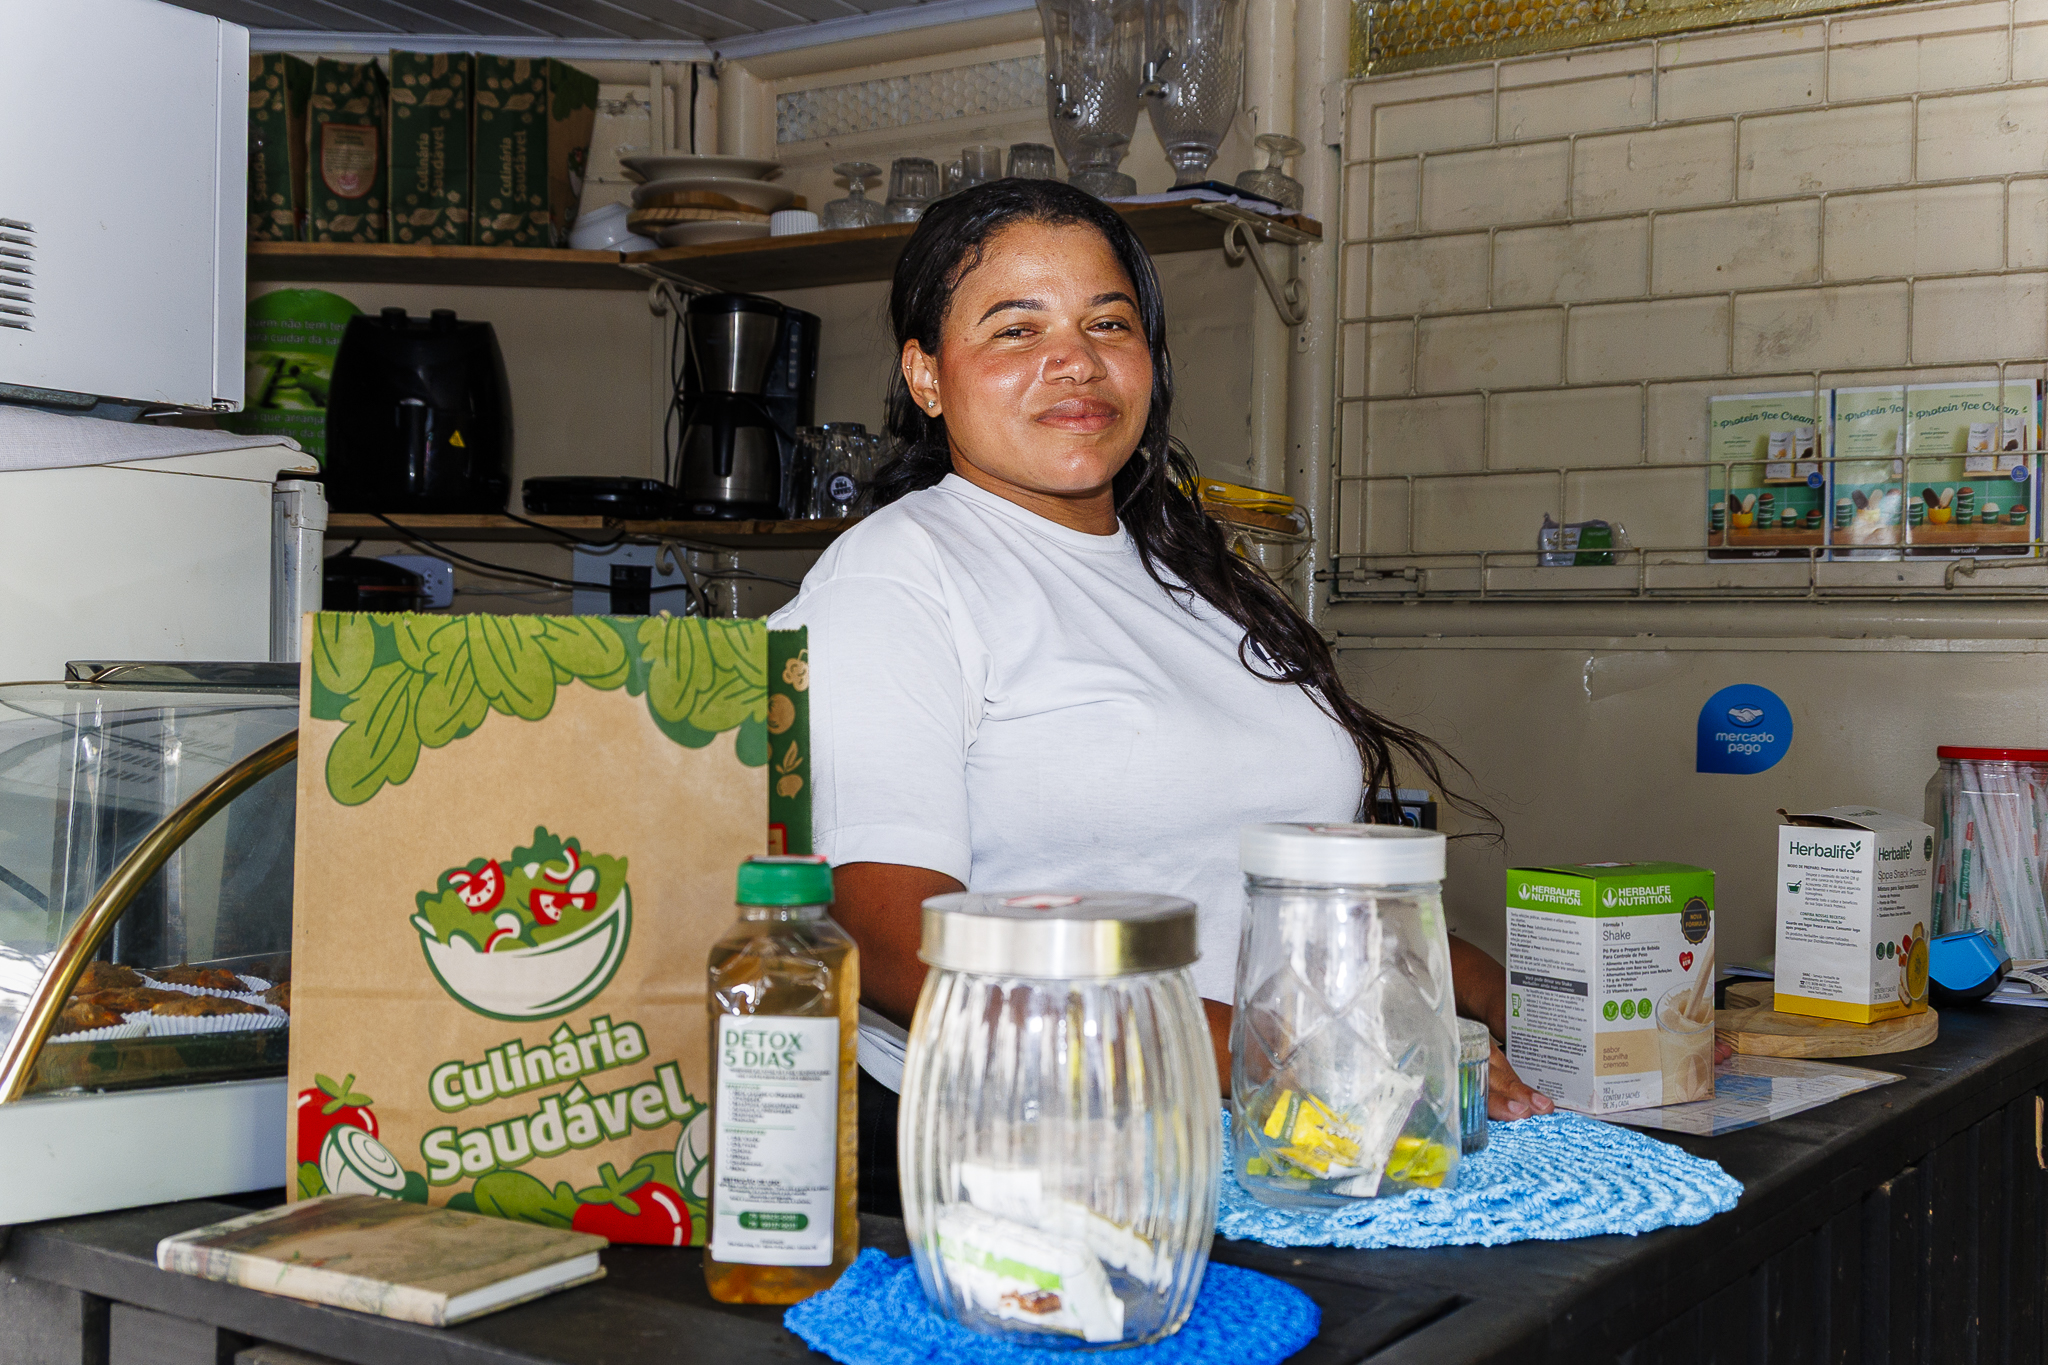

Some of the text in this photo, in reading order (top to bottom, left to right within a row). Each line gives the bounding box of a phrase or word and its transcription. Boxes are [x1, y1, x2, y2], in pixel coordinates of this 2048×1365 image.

[1845, 404, 1886, 422] Protein
[1916, 403, 1959, 419] Protein
[1962, 401, 1981, 410] Ice
[1720, 411, 1815, 428] Protein Ice Cream
[1715, 732, 1775, 743] mercado
[1727, 743, 1762, 756] pago
[1790, 841, 1855, 860] Herbalife
[1878, 846, 1910, 861] Herbalife
[1532, 885, 1581, 898] HERBALIFE
[1619, 886, 1670, 896] HERBALIFE
[1532, 893, 1581, 906] NUTRITION
[1619, 895, 1672, 906] NUTRITION
[1603, 930, 1631, 941] Shake
[725, 1029, 803, 1051] DETOX
[1603, 1046, 1620, 1054] sabor
[1603, 1053, 1628, 1061] baunilha
[429, 1015, 650, 1113] Culinária
[723, 1049, 796, 1069] 5 DIAS
[421, 1061, 695, 1186] Saudável
